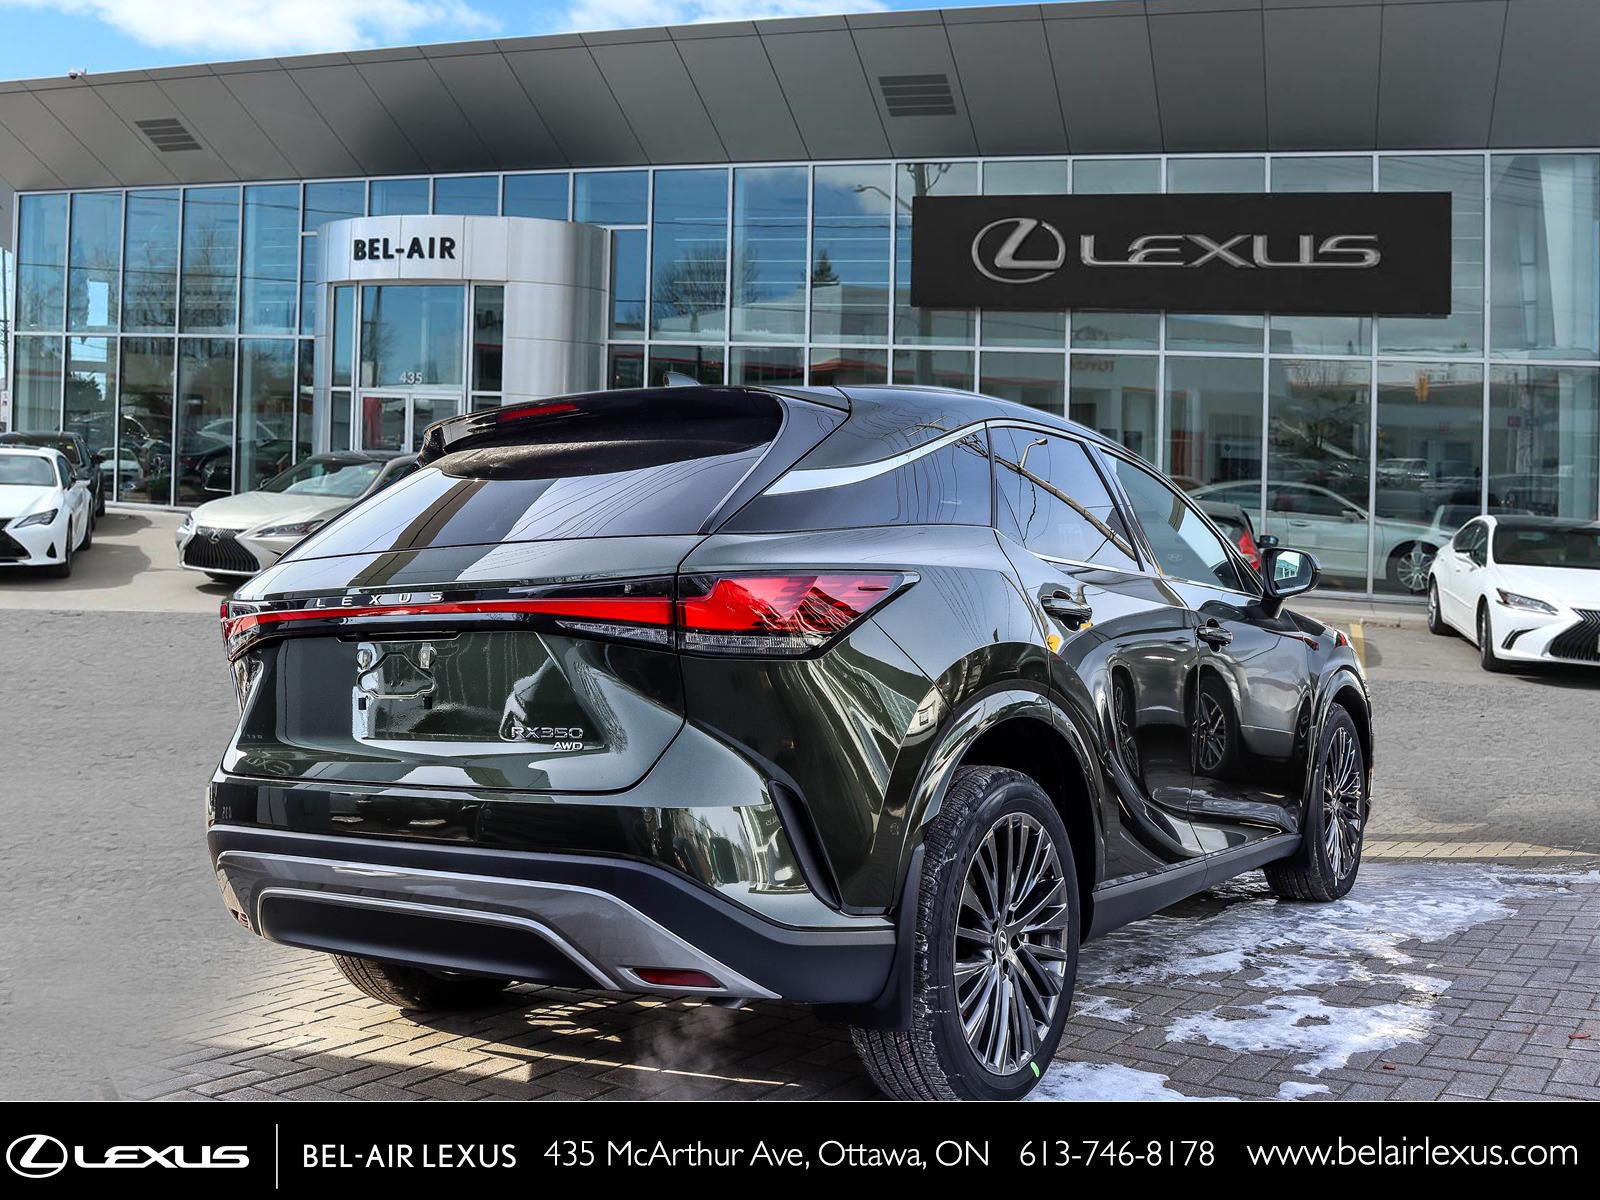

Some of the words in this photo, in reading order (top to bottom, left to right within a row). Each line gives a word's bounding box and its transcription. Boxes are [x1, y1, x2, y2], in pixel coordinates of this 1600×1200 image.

[353, 237, 456, 261] BEL-AIR
[1080, 234, 1381, 268] LEXUS
[400, 371, 423, 385] 435
[316, 591, 445, 608] LEXUS
[511, 726, 583, 739] RX350
[552, 741, 583, 752] AWD
